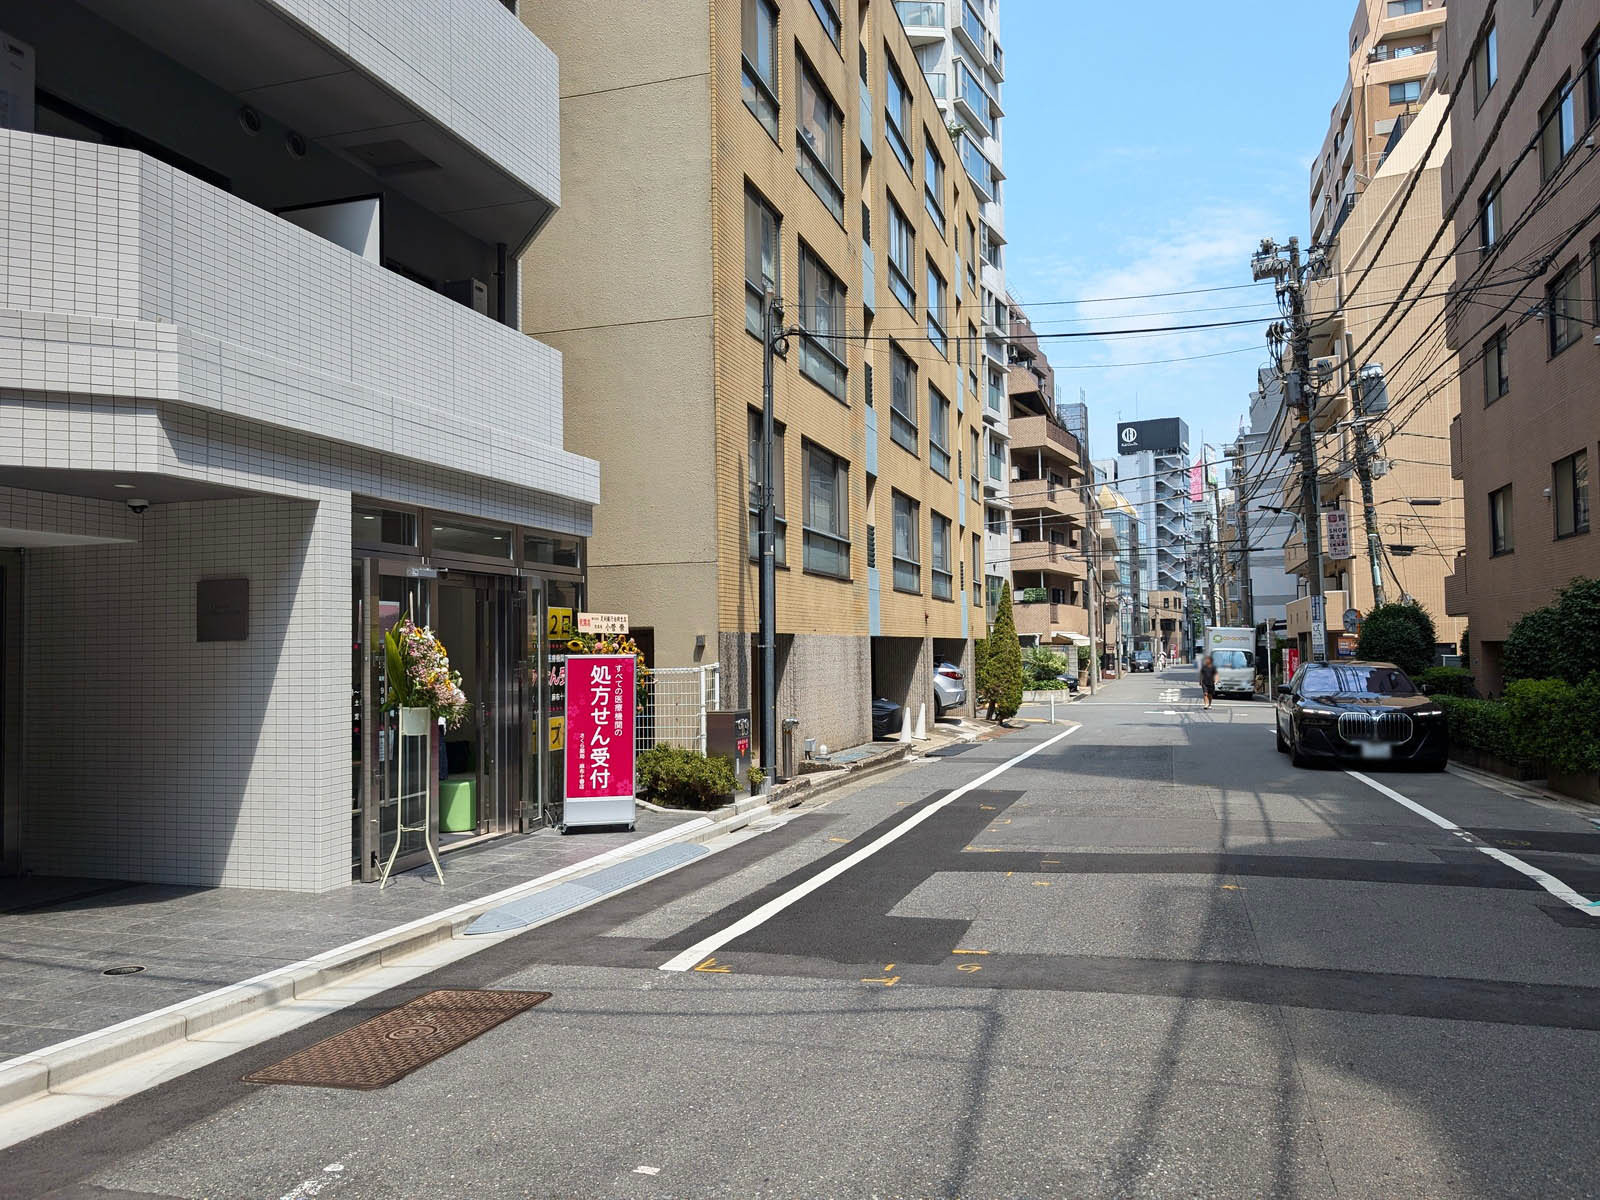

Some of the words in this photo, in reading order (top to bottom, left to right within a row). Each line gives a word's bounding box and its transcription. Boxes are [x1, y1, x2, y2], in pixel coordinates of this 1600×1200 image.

[589, 664, 612, 790] 処方せん受付
[614, 664, 624, 737] すべての医療機関の
